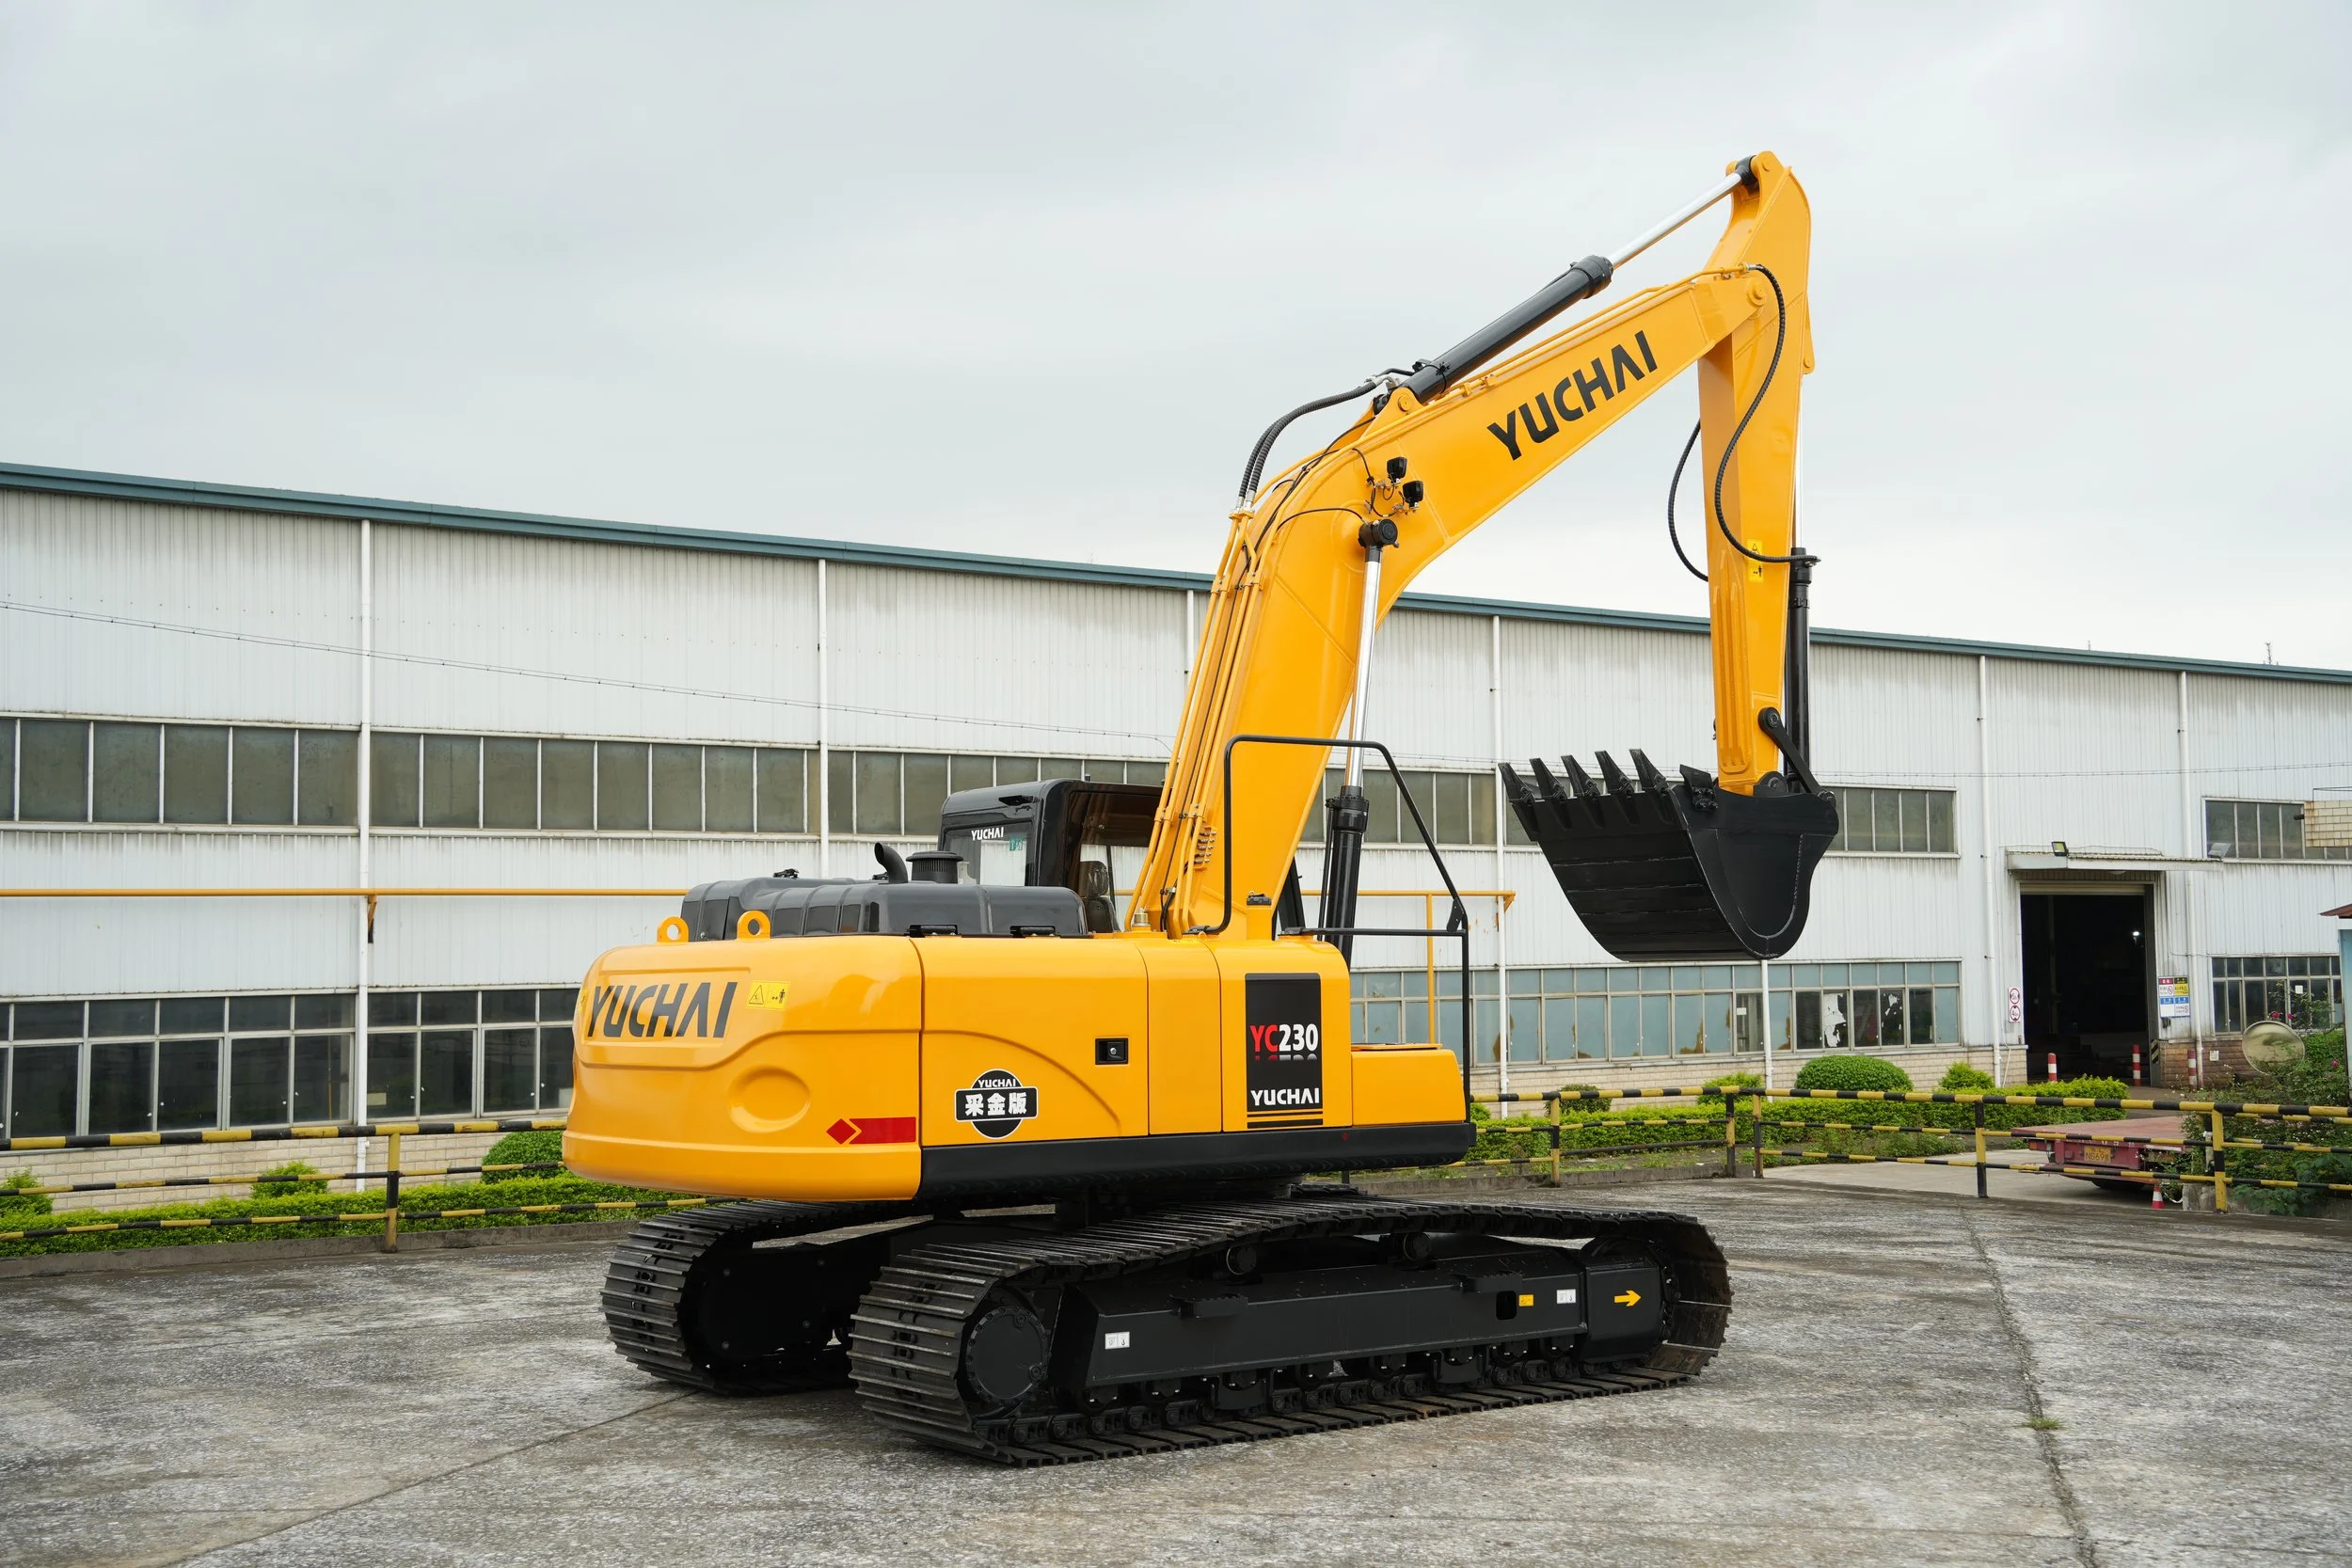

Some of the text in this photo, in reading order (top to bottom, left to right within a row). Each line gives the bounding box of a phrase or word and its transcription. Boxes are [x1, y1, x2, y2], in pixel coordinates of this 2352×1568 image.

[1486, 330, 1658, 461] YUCHAI
[971, 827, 1004, 841] YUCHAI
[587, 982, 738, 1037] YUCHAI
[1249, 1023, 1319, 1053] YC230
[978, 1078, 1017, 1088] YUCHAI
[964, 1091, 1027, 1117] 采金版
[1250, 1087, 1320, 1106] YUCHAI
